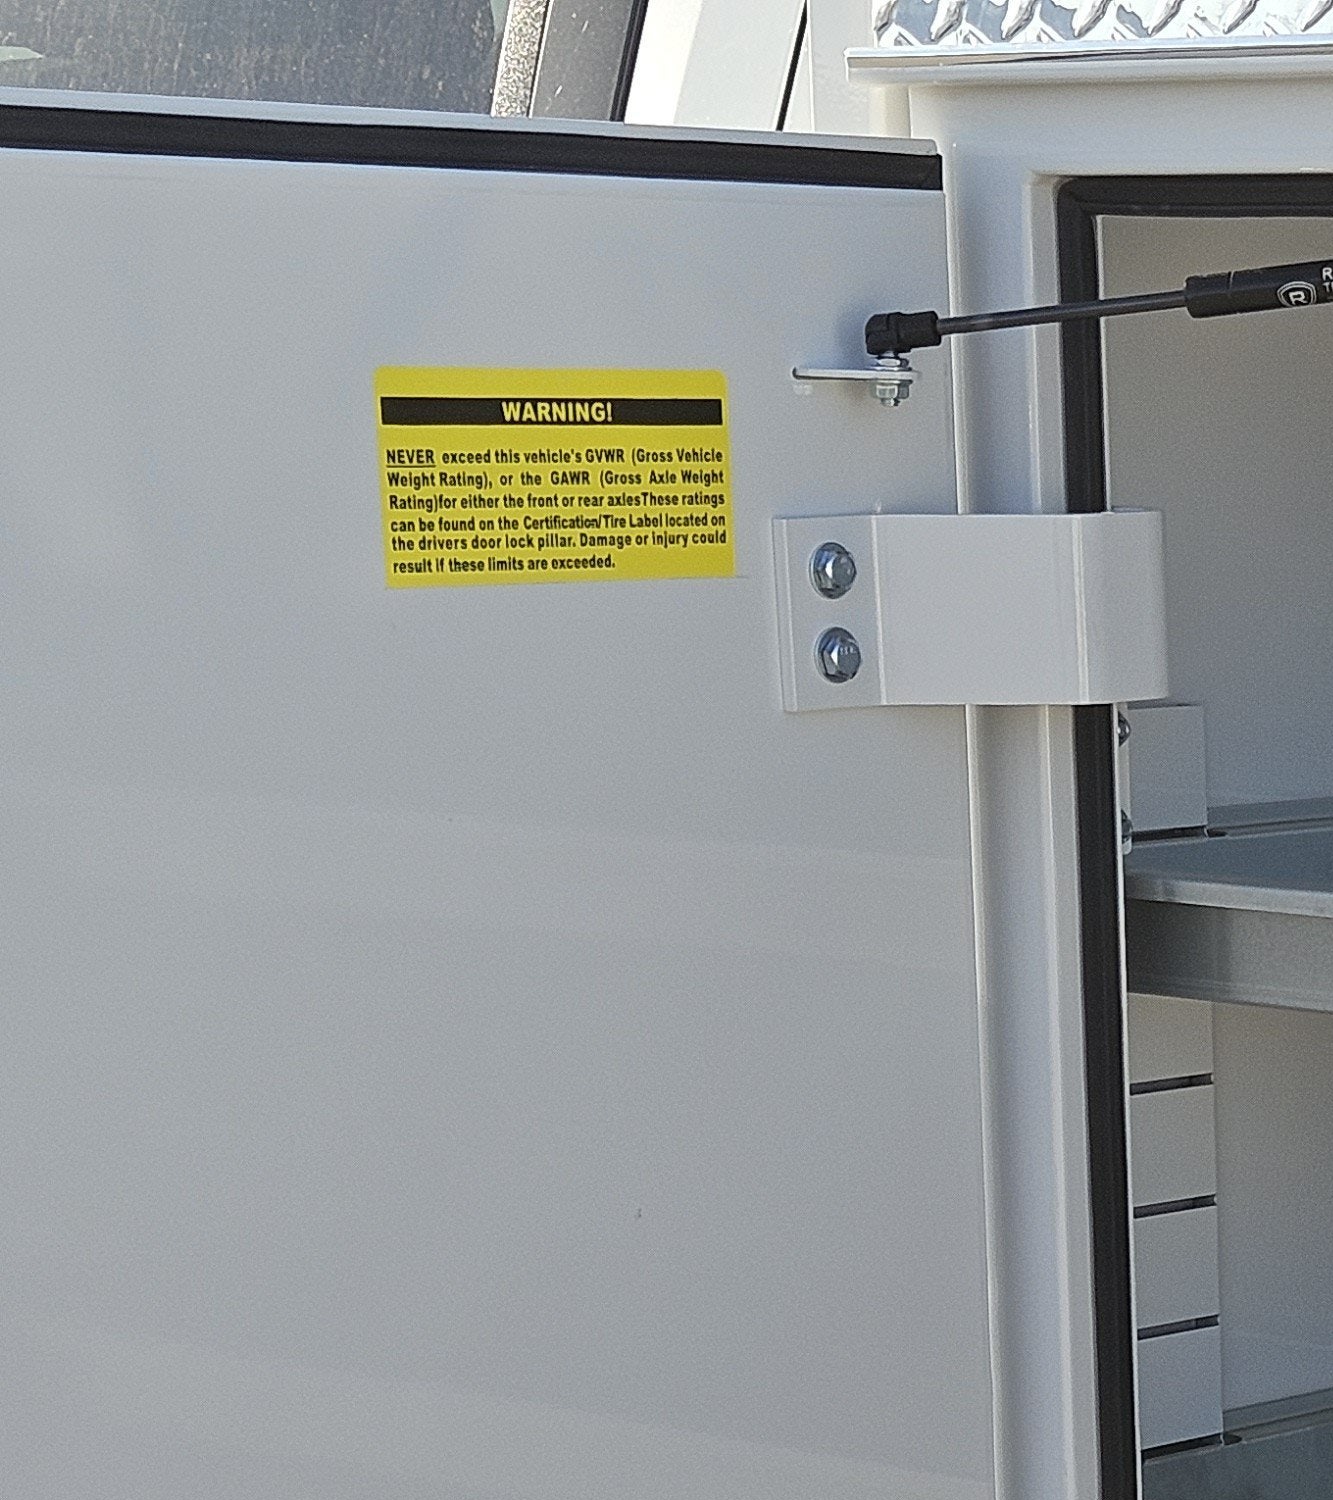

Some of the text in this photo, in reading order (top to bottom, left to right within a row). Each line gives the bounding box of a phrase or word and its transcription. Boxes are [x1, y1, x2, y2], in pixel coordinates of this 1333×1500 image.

[502, 401, 613, 423] WARNING!
[387, 448, 723, 466] NEVER exceed this vehicle's GVWR (Gross Vehicle
[387, 470, 724, 490] Weight Rating), or the GAWR (Gross Axle Weight
[461, 494, 500, 508] either
[503, 494, 524, 508] the
[527, 493, 558, 508] front
[562, 497, 575, 508] or
[578, 497, 604, 508] rear
[682, 492, 724, 509] ratings
[391, 520, 415, 533] can
[419, 517, 435, 532] be
[439, 516, 475, 531] found
[479, 519, 494, 530] on
[498, 516, 518, 530] the
[629, 515, 663, 528] Label
[666, 513, 708, 527] located
[711, 516, 725, 527] on
[392, 530, 727, 551] the drivers door lock pillar. Damage or injury could
[393, 555, 615, 574] result if these limits are exceeded.
